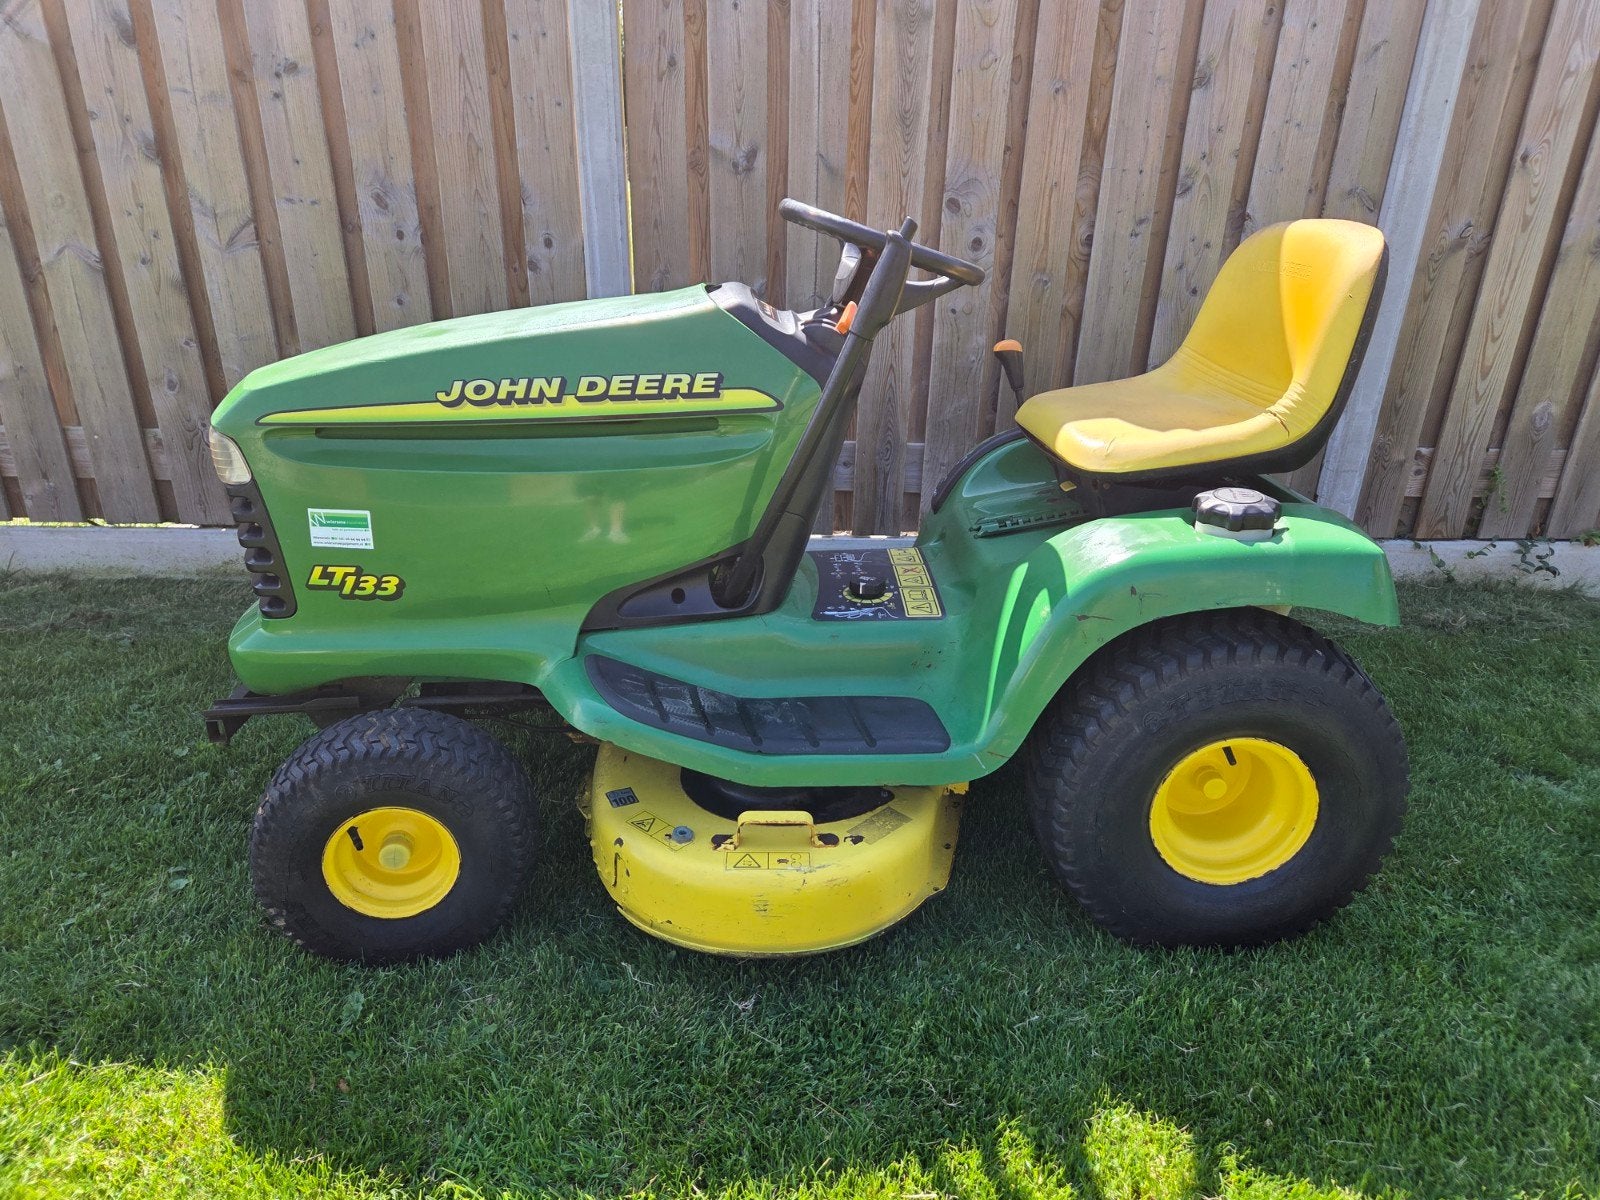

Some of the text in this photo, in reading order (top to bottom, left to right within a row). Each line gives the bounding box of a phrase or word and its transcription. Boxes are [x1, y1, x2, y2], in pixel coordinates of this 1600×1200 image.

[436, 372, 721, 404] JOHN DEERE
[306, 565, 403, 599] LT133
